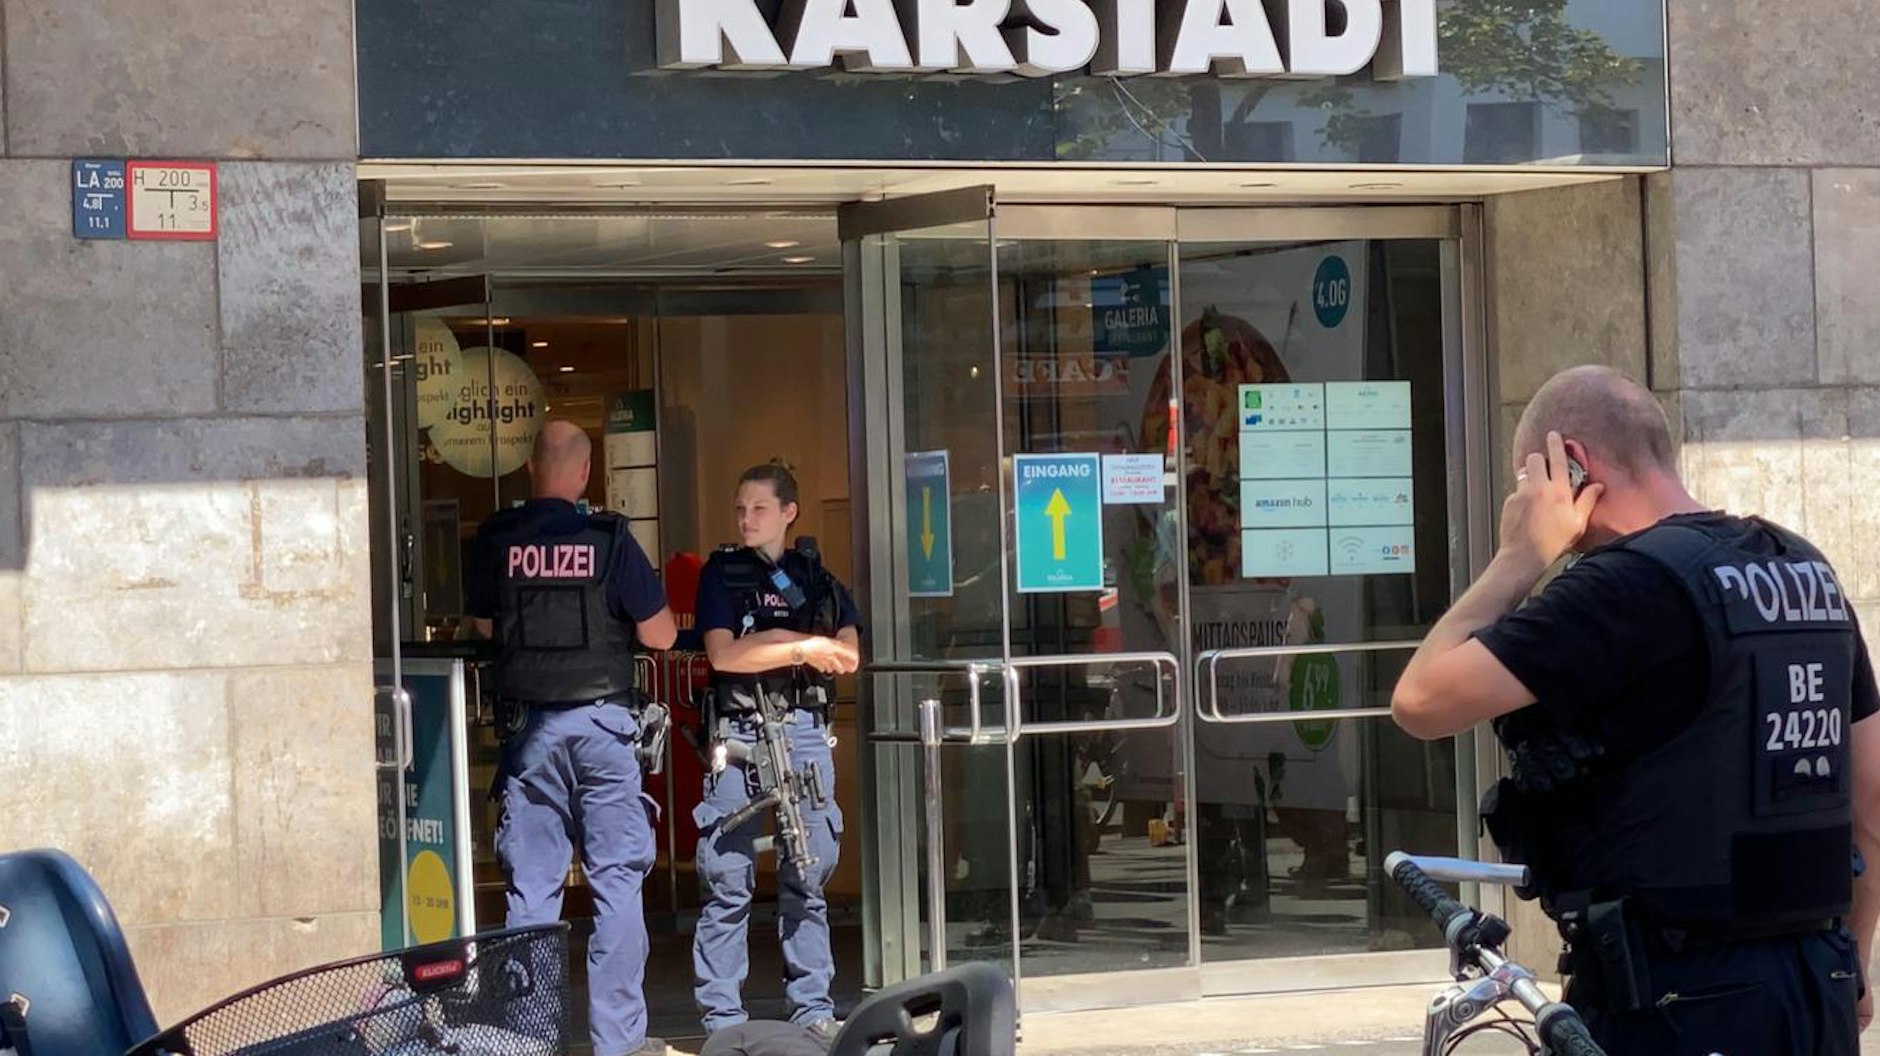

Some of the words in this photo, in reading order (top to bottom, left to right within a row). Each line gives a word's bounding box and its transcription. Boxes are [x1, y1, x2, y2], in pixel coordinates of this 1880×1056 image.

[77, 171, 100, 188] LA
[104, 177, 124, 189] 200
[134, 170, 145, 186] H
[159, 170, 191, 187] 200
[1105, 305, 1159, 330] GALERIA
[419, 337, 444, 353] ein
[460, 378, 499, 402] glich
[505, 380, 528, 396] ein
[446, 399, 535, 425] ighlight
[1023, 464, 1090, 478] EINGANG
[508, 544, 595, 578] POLIZEI
[1788, 663, 1824, 703] BE
[1766, 708, 1842, 750] 24220
